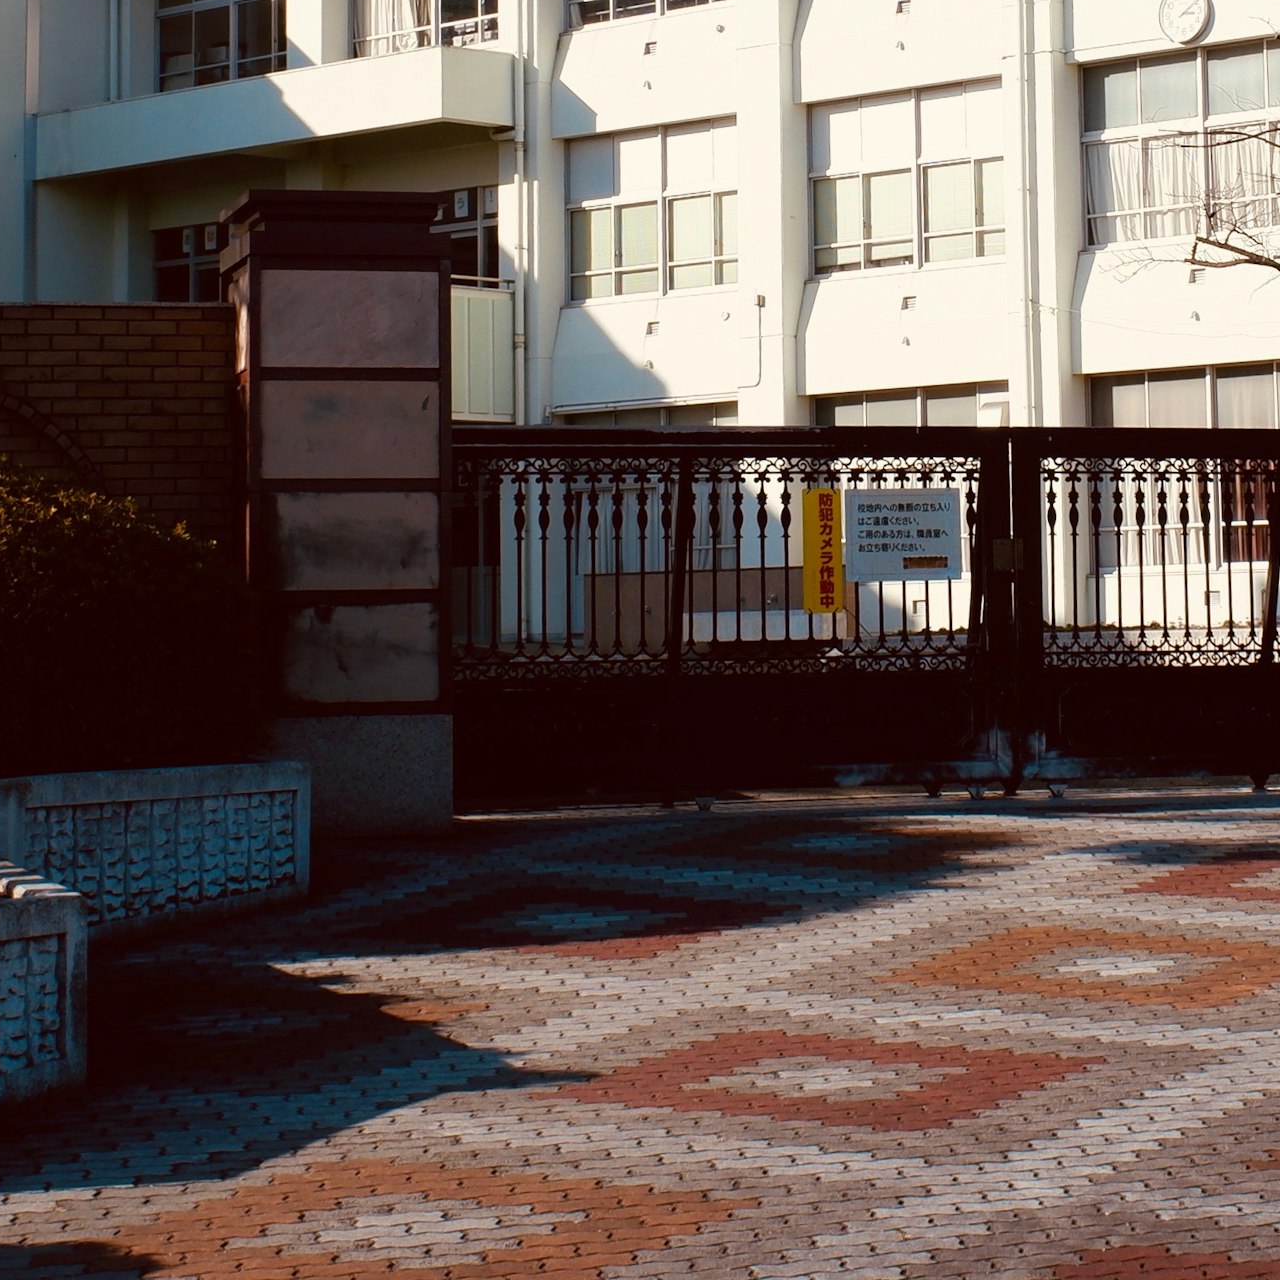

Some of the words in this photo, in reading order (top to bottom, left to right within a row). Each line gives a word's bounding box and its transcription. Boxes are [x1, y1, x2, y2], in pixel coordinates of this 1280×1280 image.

[857, 502, 951, 513] 校地内への無断の立ち入り
[857, 516, 920, 526] はご遠慮ください。
[819, 493, 835, 608] 防犯カメラ作動中
